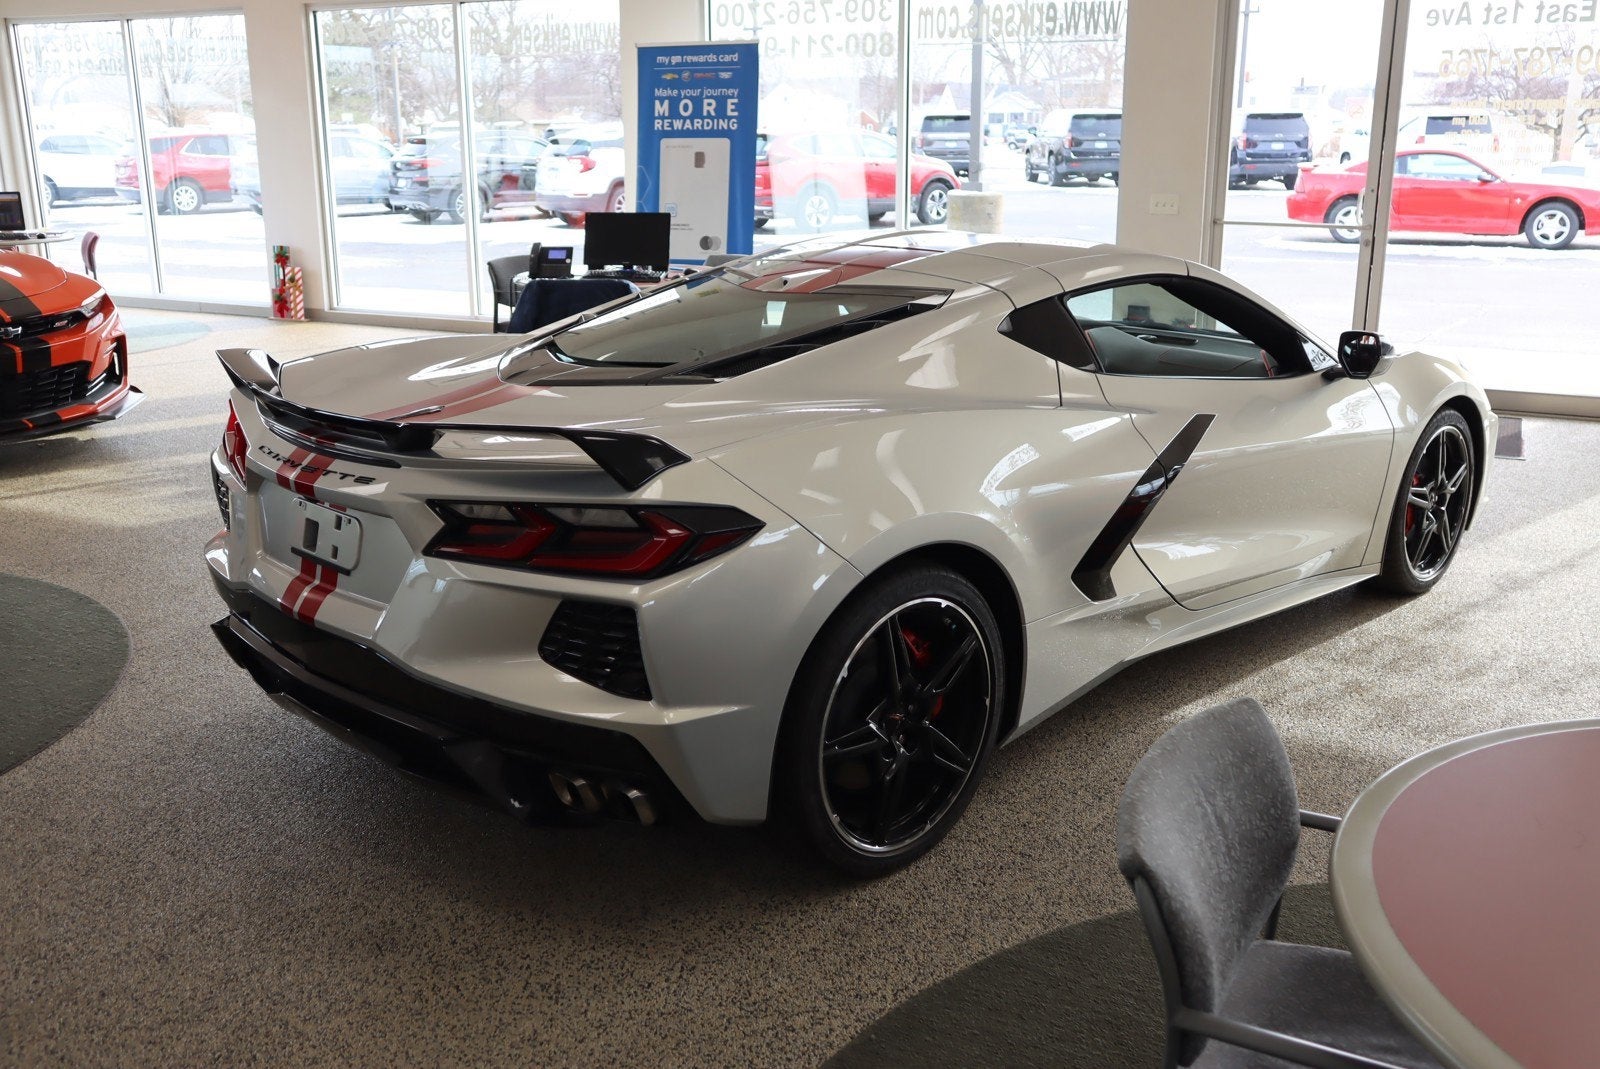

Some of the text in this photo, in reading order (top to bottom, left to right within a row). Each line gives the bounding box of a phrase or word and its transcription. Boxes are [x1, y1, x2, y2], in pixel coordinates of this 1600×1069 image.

[656, 52, 739, 65] my gm rewards card
[655, 87, 739, 98] Make your journey
[654, 98, 739, 117] MORE
[654, 119, 738, 131] REWARDING
[258, 445, 376, 485] CORVETTE
